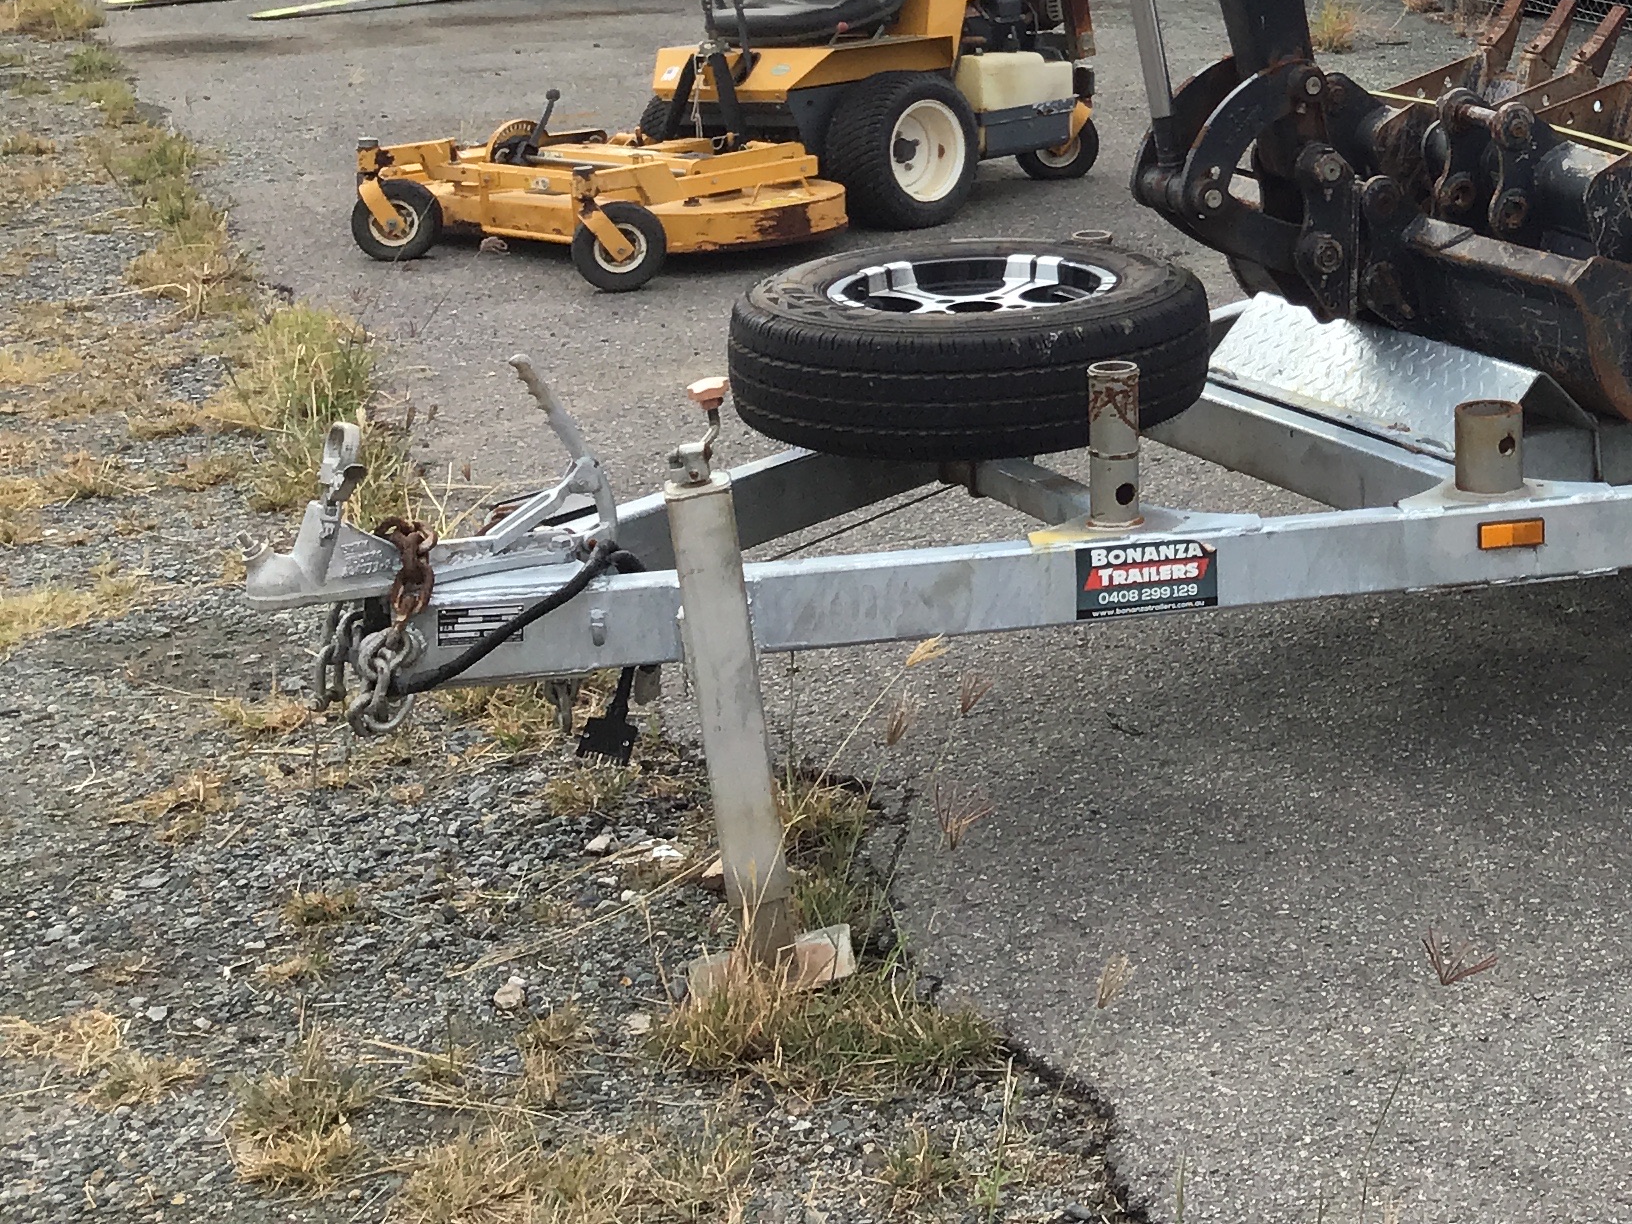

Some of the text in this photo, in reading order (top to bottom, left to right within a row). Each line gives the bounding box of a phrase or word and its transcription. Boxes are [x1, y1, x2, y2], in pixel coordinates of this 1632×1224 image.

[1090, 543, 1203, 567] BONANZA
[1098, 562, 1199, 587] TRAILERS
[1098, 583, 1198, 605] 0408 299 129
[1092, 599, 1205, 617] www.bonanzatrailers.com.au
